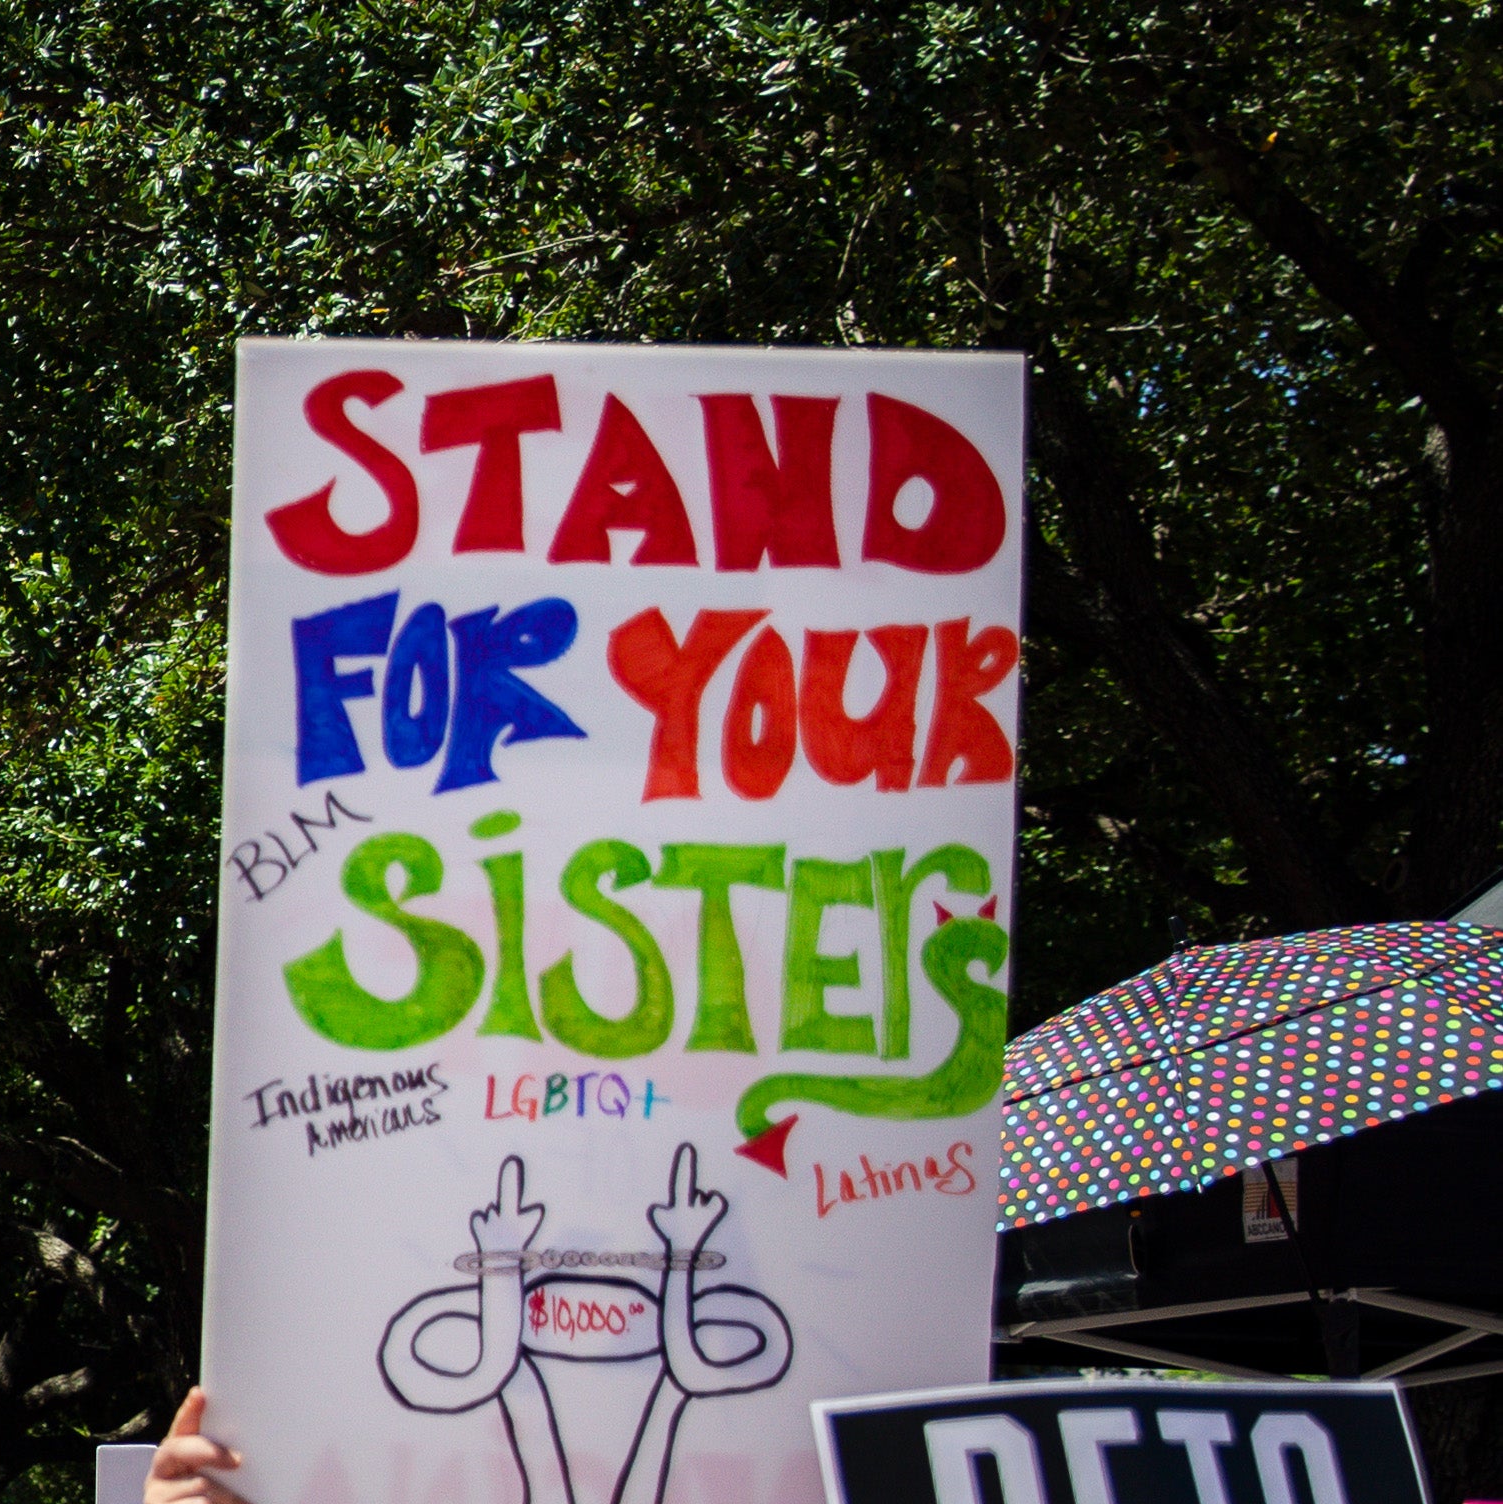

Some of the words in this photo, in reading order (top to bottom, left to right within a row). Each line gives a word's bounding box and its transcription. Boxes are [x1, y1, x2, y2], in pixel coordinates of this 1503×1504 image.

[265, 368, 1006, 576] STAND
[292, 589, 589, 796] FOR
[606, 607, 1020, 803] YOUR
[225, 792, 373, 904] BLM
[244, 1063, 449, 1130] Indigenous
[484, 1072, 671, 1124] LGBTQ+
